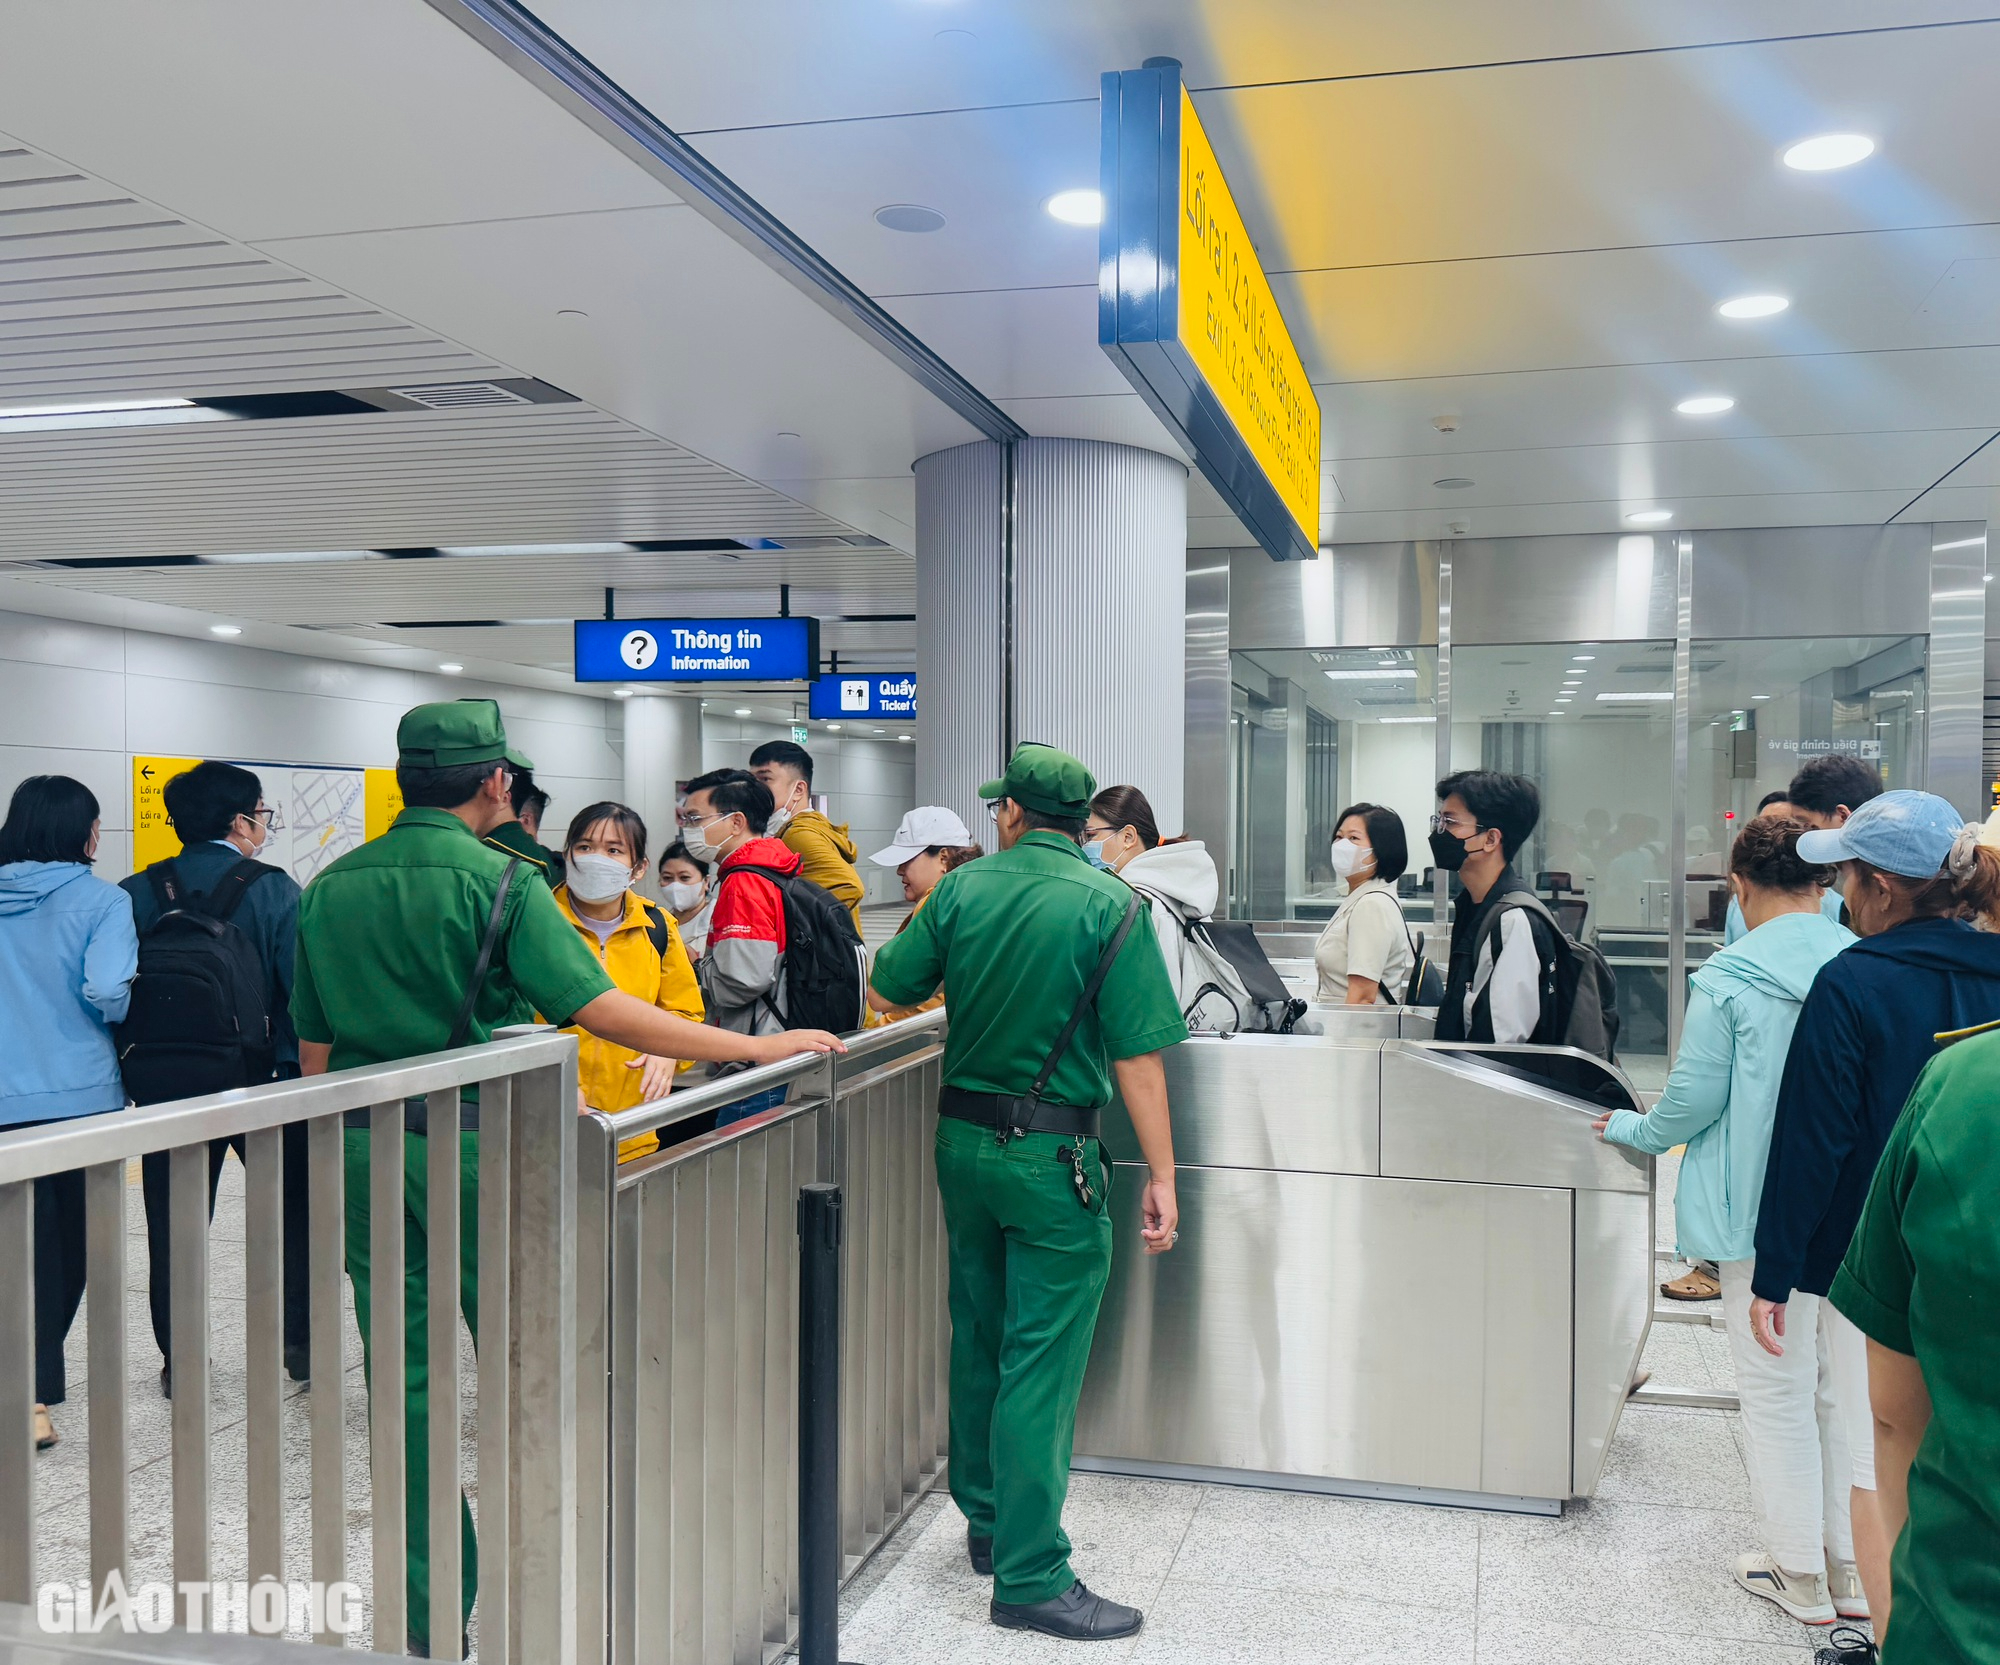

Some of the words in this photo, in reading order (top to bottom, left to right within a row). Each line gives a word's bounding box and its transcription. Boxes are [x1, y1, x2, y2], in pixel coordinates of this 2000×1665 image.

[1186, 145, 1206, 248] Lối
[1209, 213, 1221, 279] ra
[1243, 274, 1249, 333] 3
[1267, 341, 1275, 391] ra
[1207, 290, 1222, 358] Exit
[671, 629, 731, 654] Thông
[738, 629, 762, 650] tin
[671, 655, 750, 671] Information
[879, 700, 910, 711] Ticket
